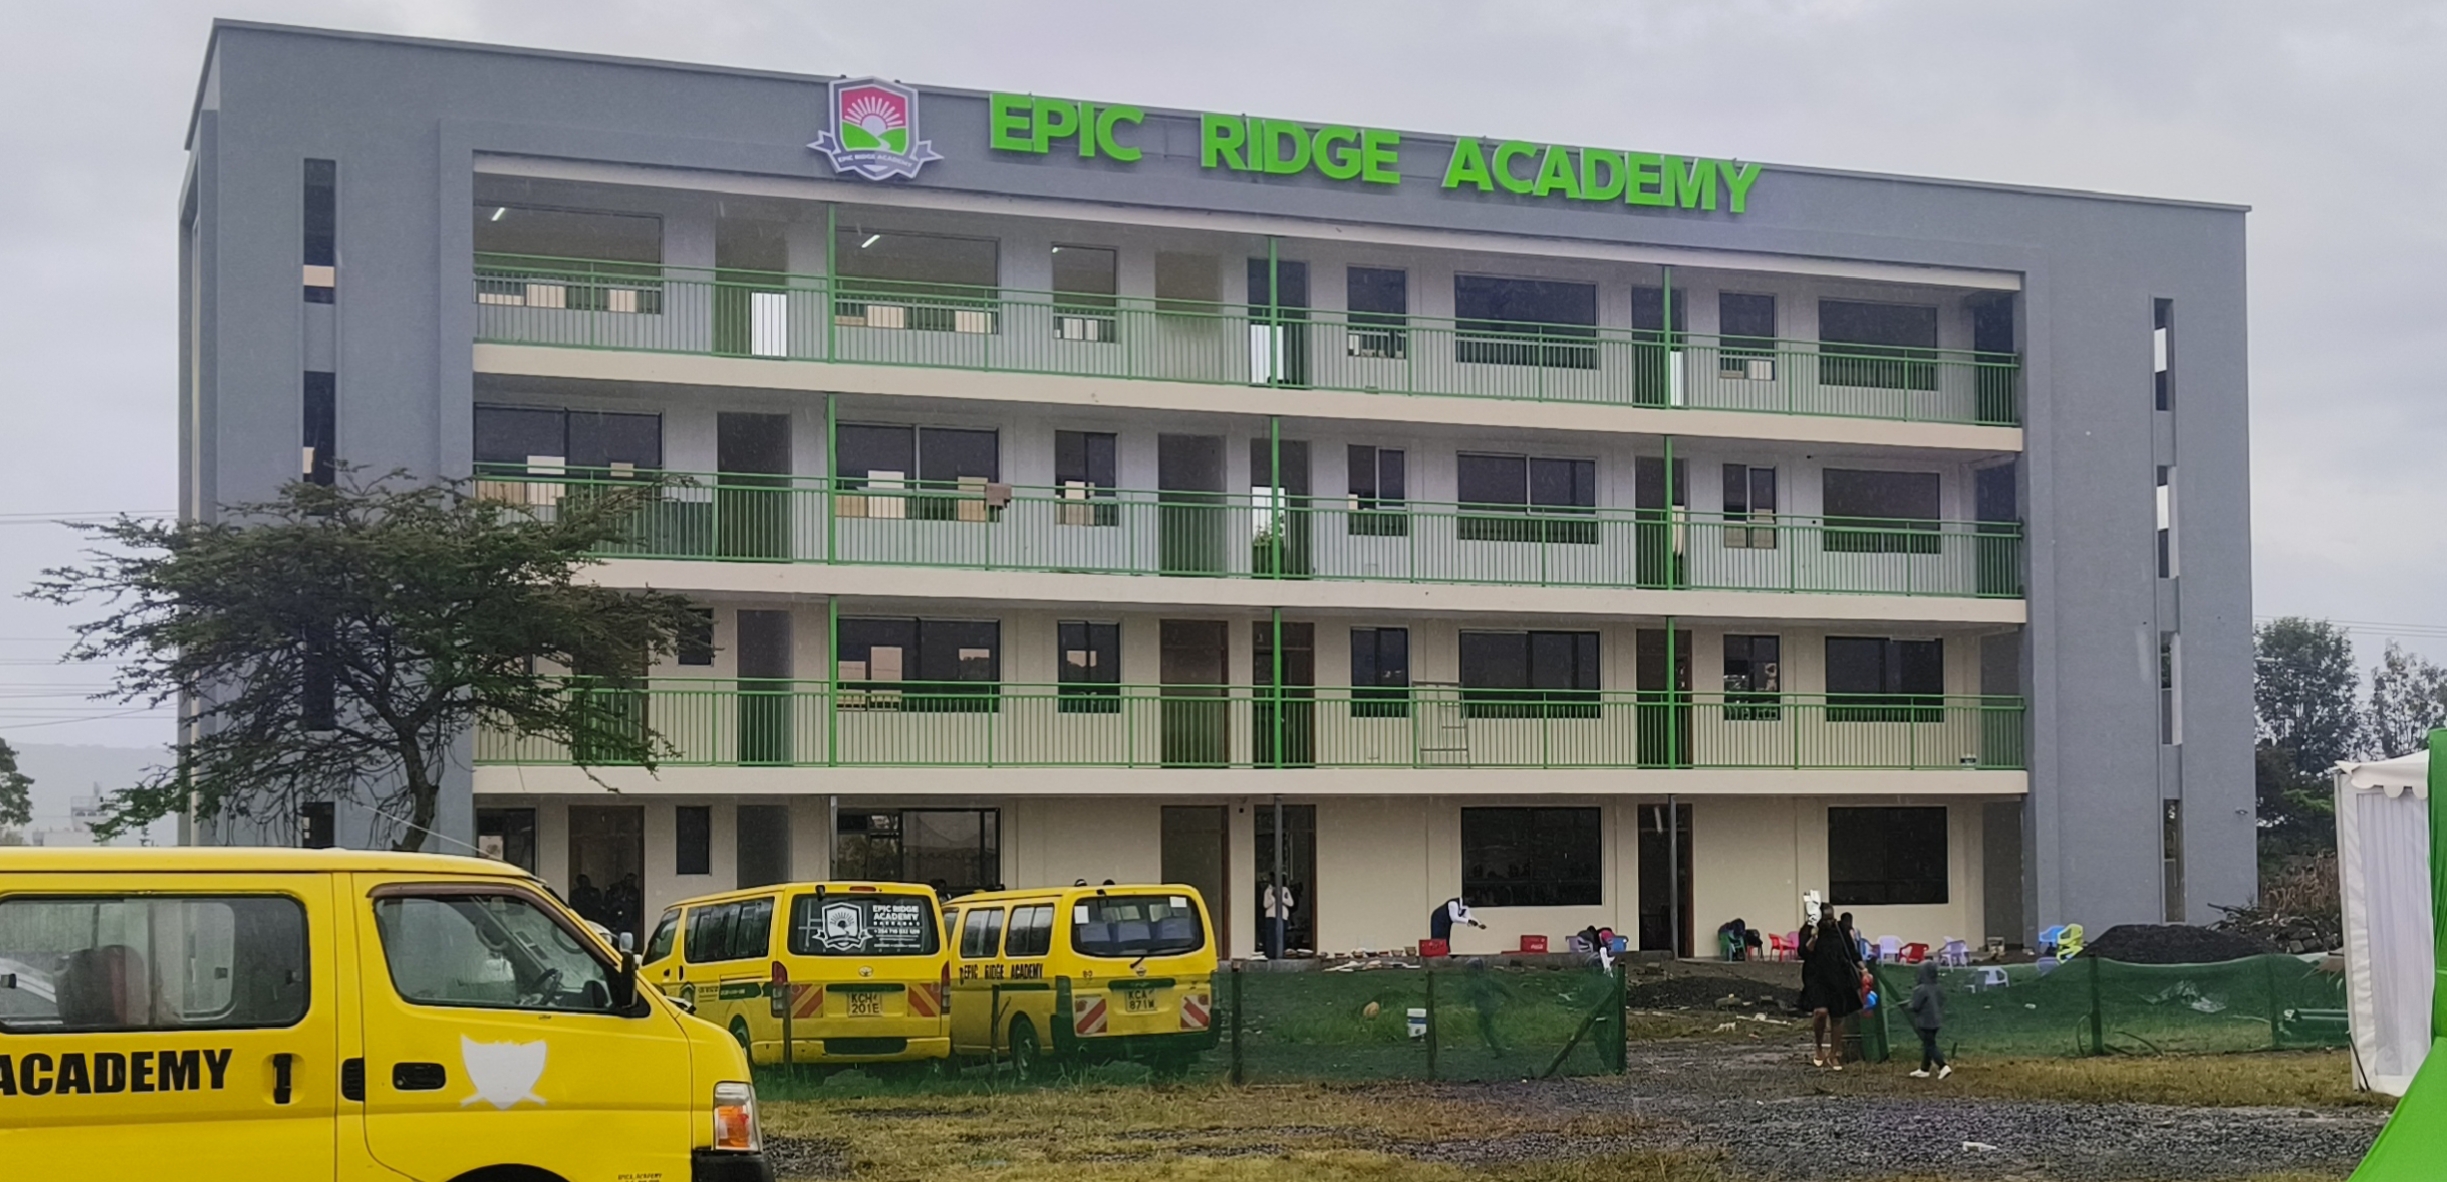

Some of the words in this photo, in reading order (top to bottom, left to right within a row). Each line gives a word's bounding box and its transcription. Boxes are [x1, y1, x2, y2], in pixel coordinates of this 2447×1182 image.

[989, 91, 1145, 162] EPIC
[1200, 112, 1400, 184] RIDGE
[1441, 137, 1762, 213] ACADEMY
[876, 153, 913, 168] ACADEMY
[872, 904, 892, 913] EPIC
[873, 912, 920, 921] ACADEMY
[964, 963, 979, 980] EPIC
[985, 963, 1005, 980] RIDGE
[1010, 962, 1044, 980] ACADEMY
[851, 993, 873, 1004] KCH
[1127, 989, 1148, 1000] KCA
[851, 1003, 880, 1014] 201E
